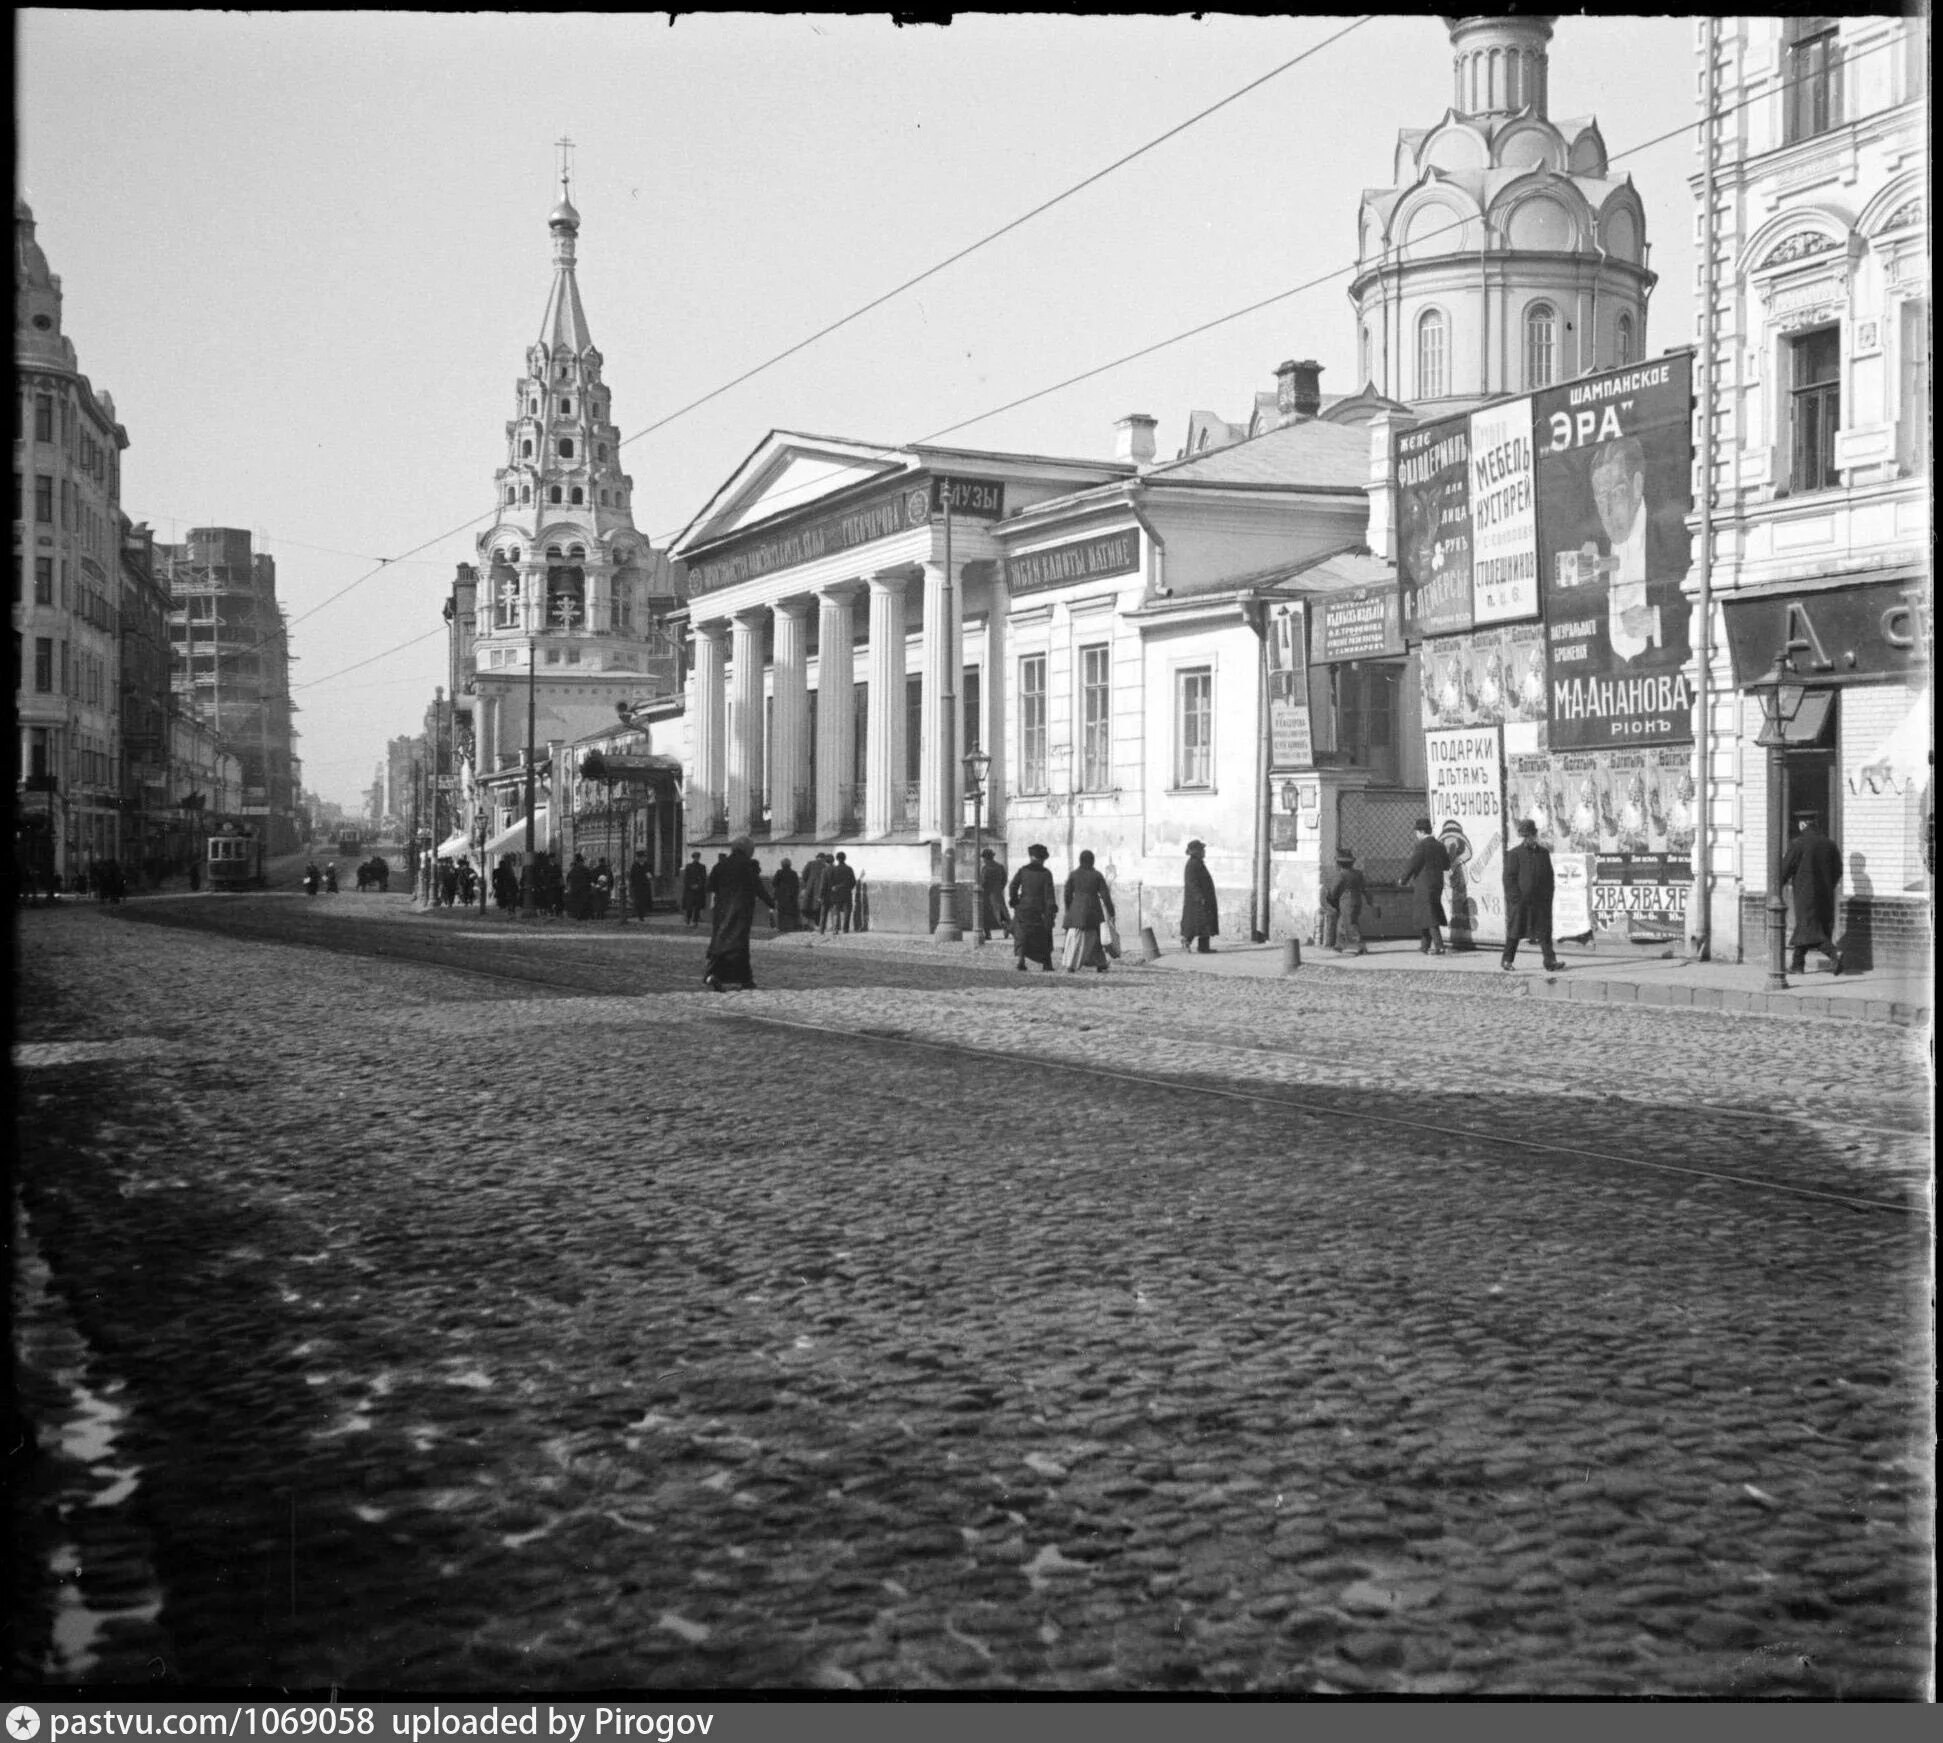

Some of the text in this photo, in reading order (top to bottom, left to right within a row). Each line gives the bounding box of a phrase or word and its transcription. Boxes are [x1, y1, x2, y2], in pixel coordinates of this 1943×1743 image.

[1570, 365, 1670, 406] ШАМПАНСКОЕ
[1475, 436, 1530, 492] МЕБЕЛЬ
[1441, 505, 1467, 525] ЛИЦА
[1610, 718, 1672, 736] РІОНЪ
[1430, 738, 1493, 763] ПОДАРКИ
[1430, 789, 1500, 826] ГЛАЗУНОВЪ
[1594, 886, 1627, 910] ЯВА
[1629, 886, 1662, 910] ЯВА
